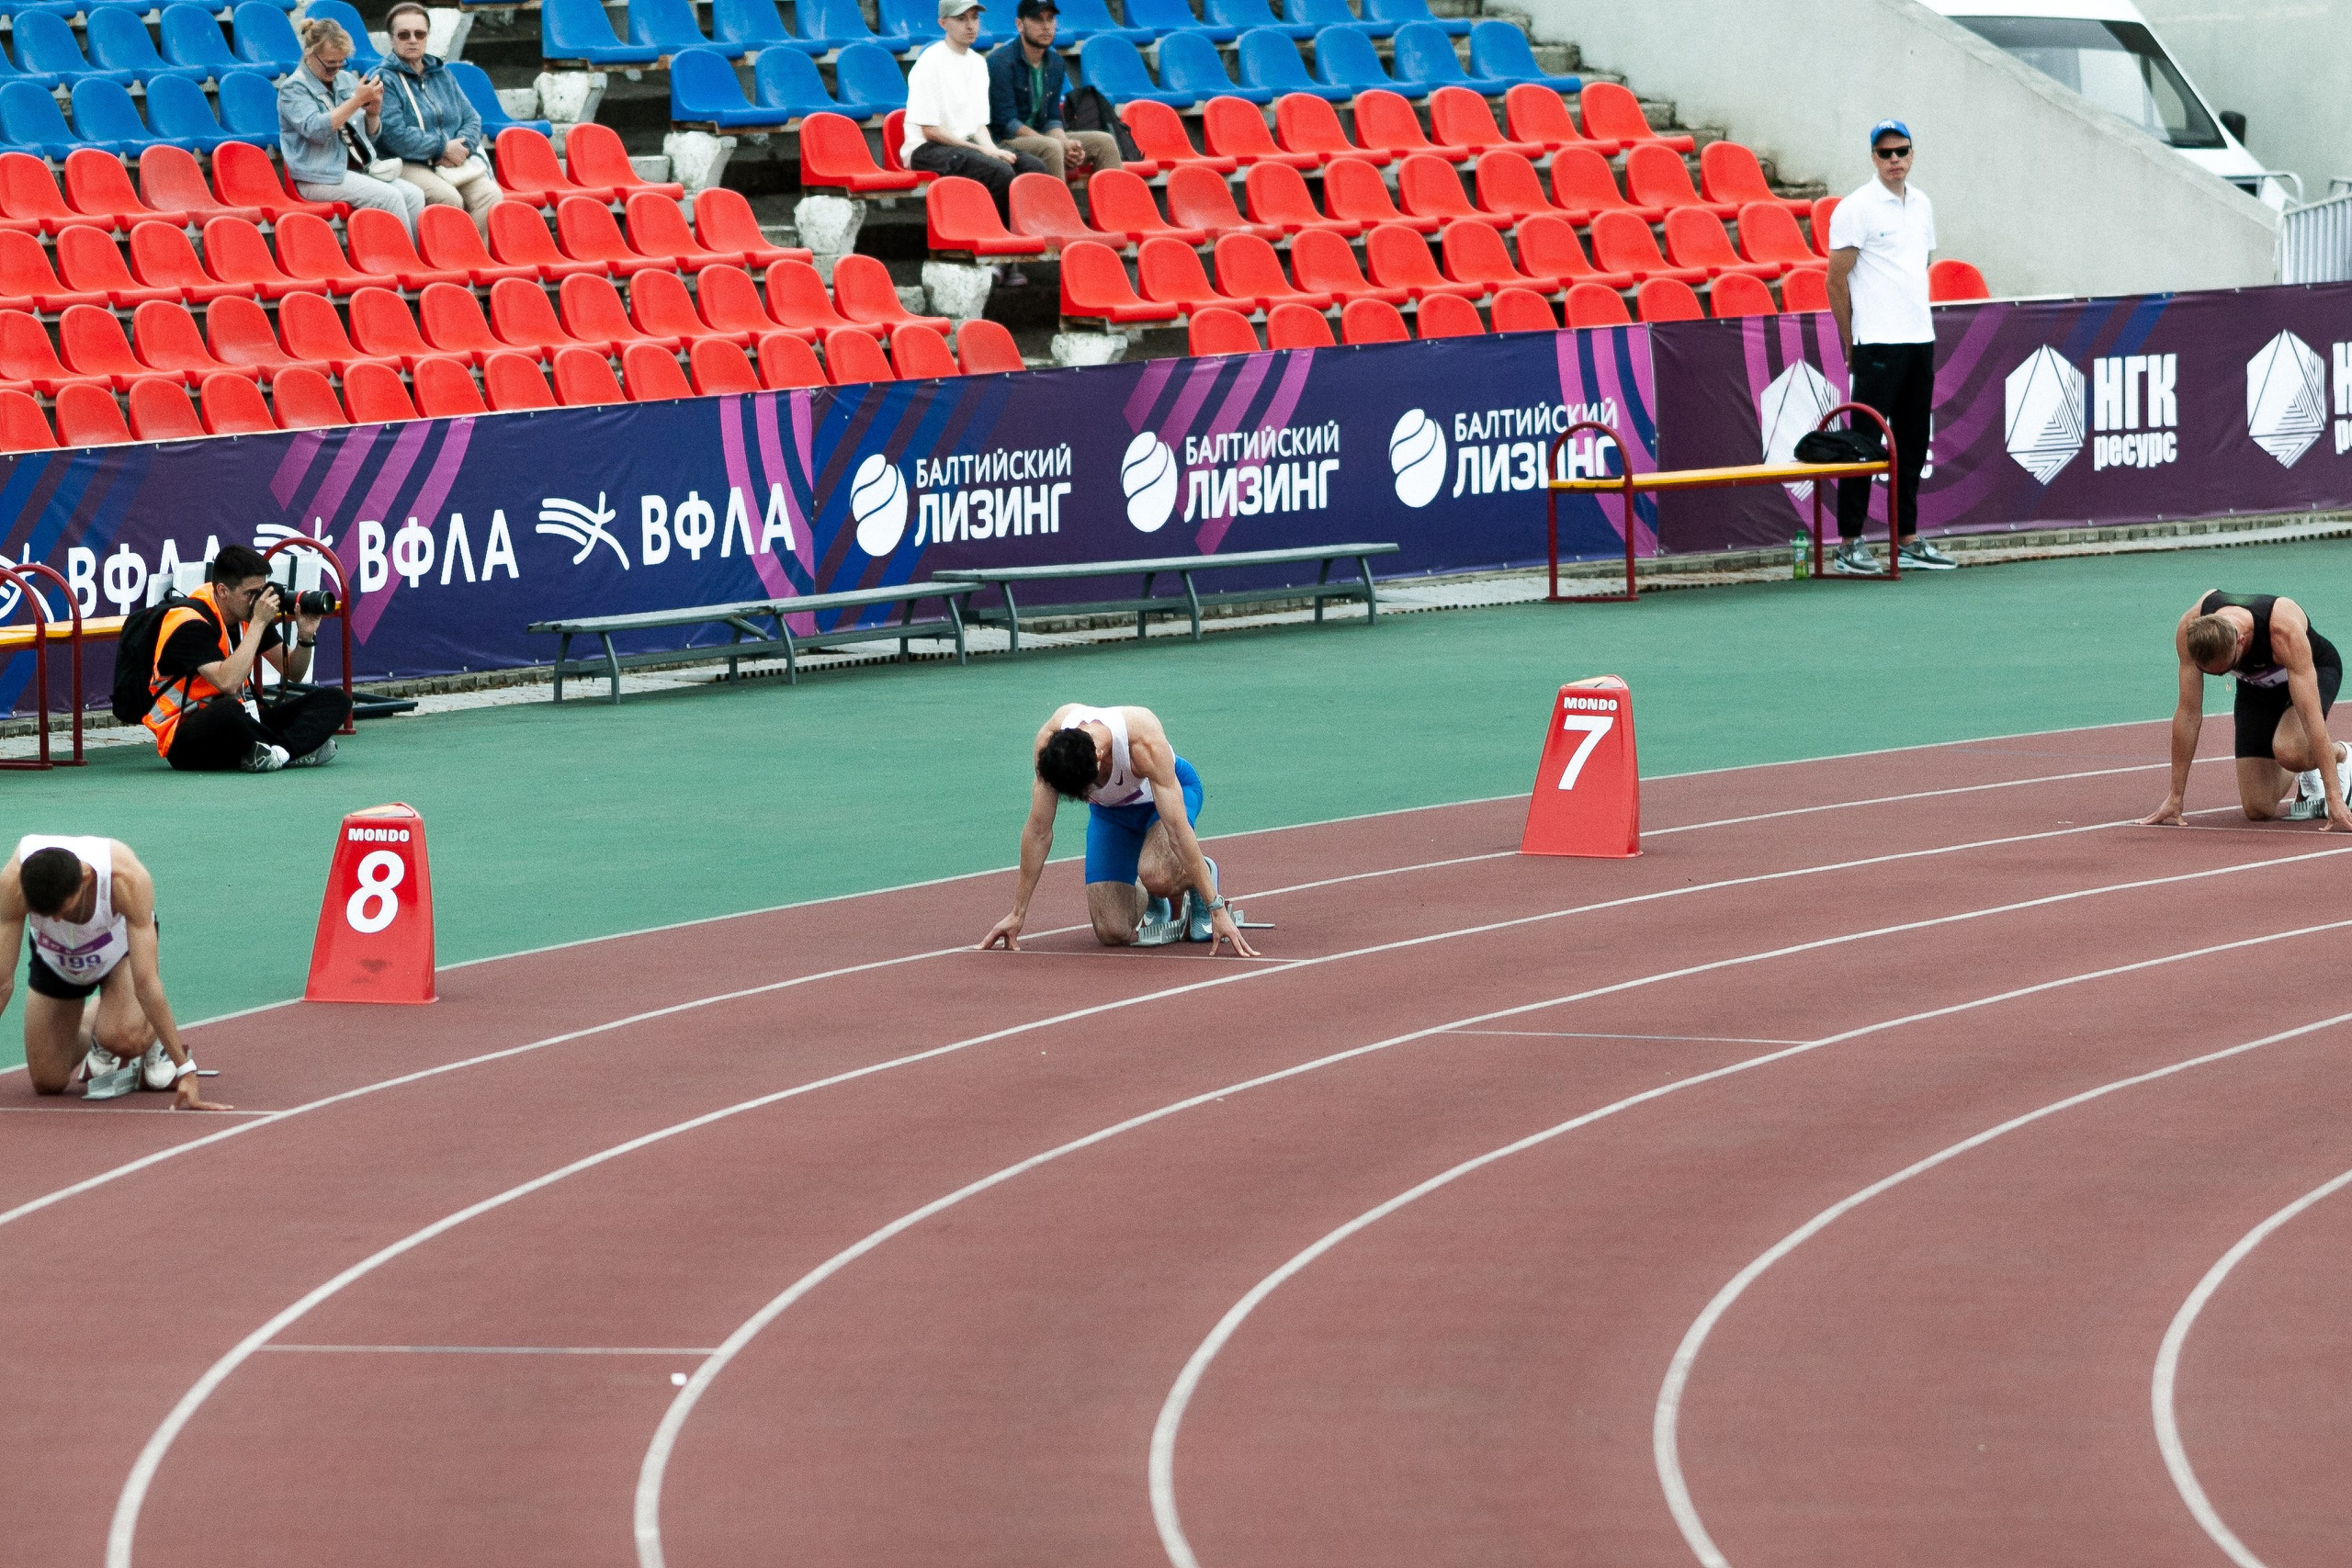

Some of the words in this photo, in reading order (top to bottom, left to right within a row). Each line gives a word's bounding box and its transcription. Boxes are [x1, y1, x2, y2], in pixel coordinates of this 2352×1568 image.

[1454, 397, 1618, 442] БАЛТИЙСКИЙ
[2093, 354, 2177, 431] НГК
[915, 443, 1071, 489] БАЛТИЙСКИЙ
[1184, 419, 1340, 466] БАЛТИЙСКИЙ
[2093, 430, 2177, 471] ресурс
[914, 482, 1071, 547] ЛИЗИНГ
[1183, 458, 1340, 524] ЛИЗИНГ
[358, 509, 520, 593] ВФЛА
[641, 482, 797, 566] ВФЛА
[1563, 696, 1618, 711] MONDO
[1557, 714, 1614, 791] 7
[347, 828, 411, 843] MONDO
[345, 850, 405, 934] 8
